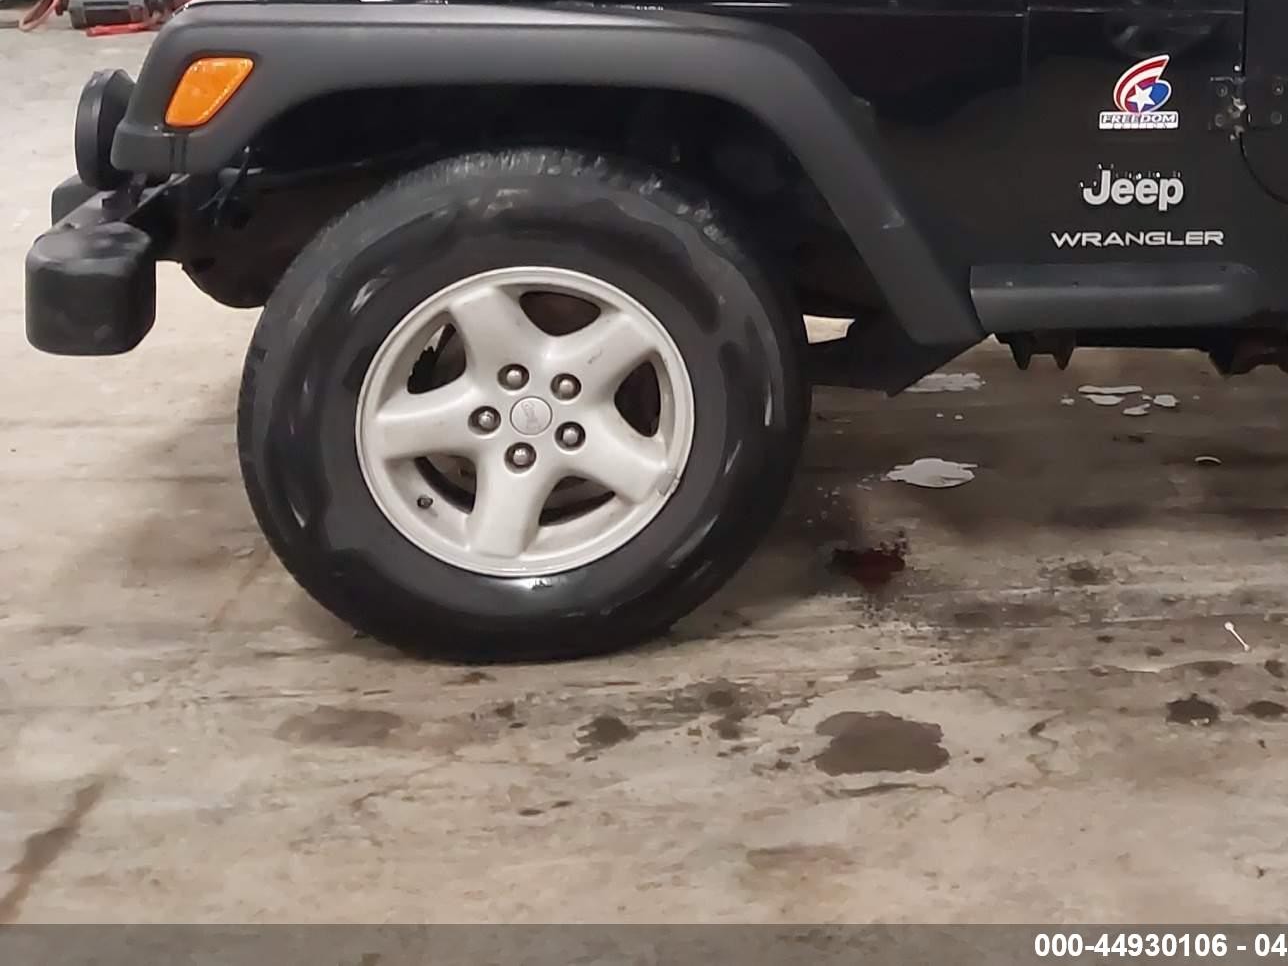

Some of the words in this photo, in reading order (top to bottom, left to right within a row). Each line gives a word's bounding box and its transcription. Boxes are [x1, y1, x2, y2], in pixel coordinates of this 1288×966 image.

[1101, 114, 1177, 124] FREEDOM
[1083, 169, 1184, 211] Jeep
[1051, 231, 1224, 248] WRANGLER
